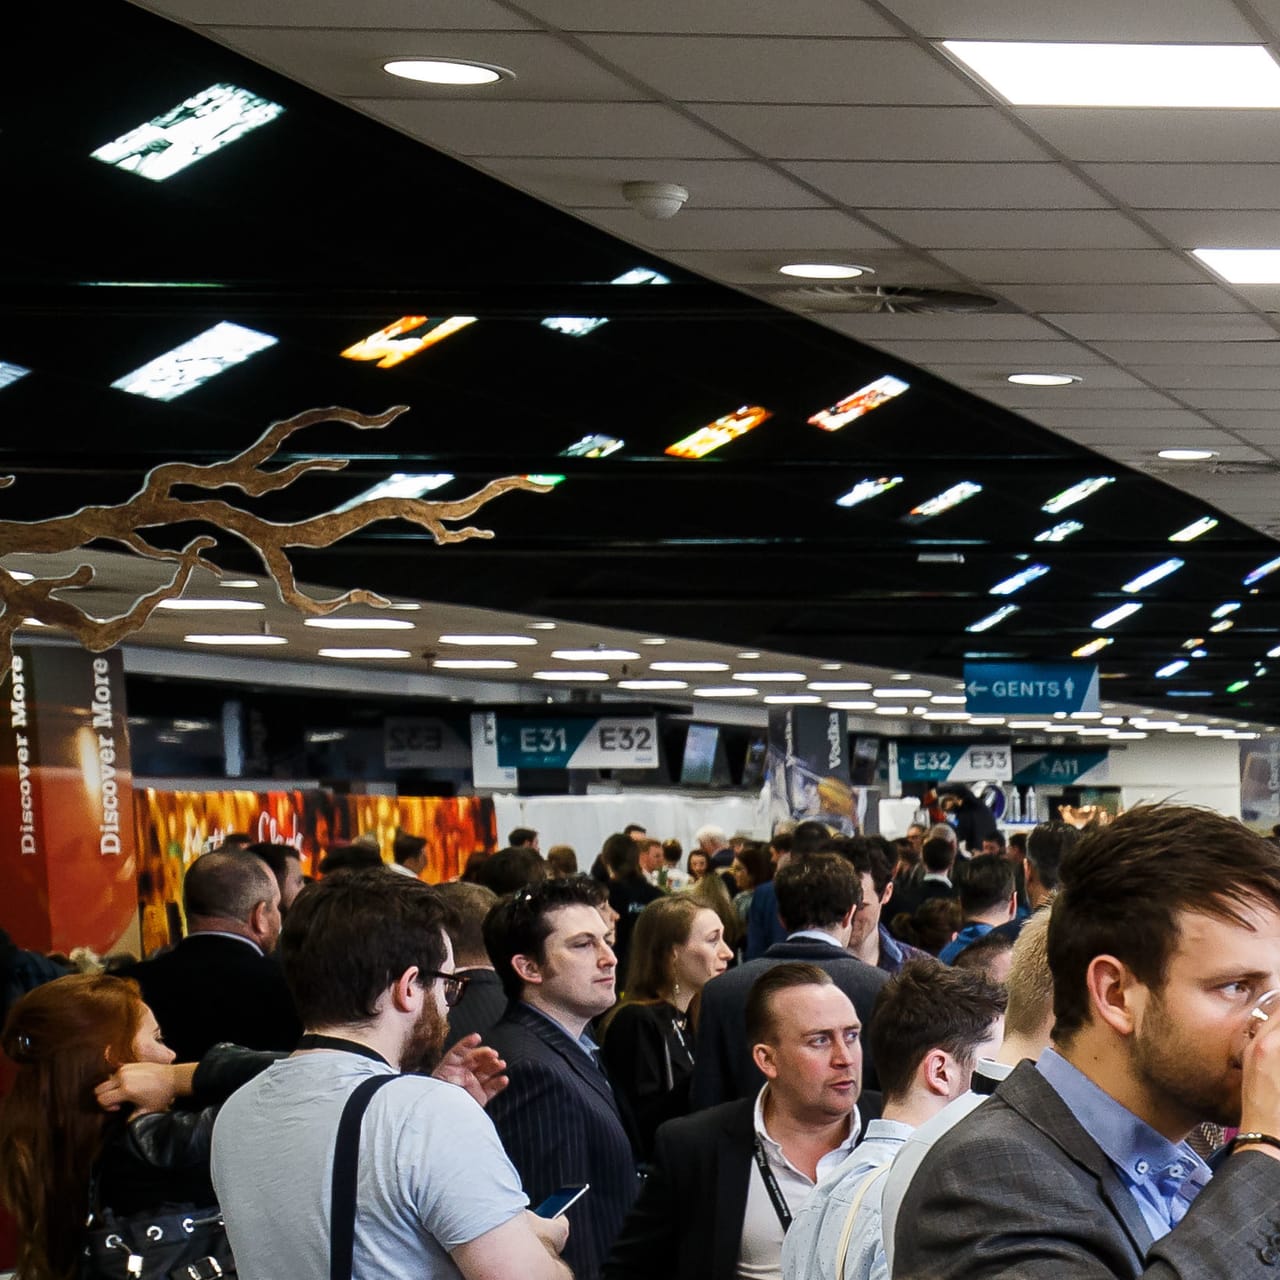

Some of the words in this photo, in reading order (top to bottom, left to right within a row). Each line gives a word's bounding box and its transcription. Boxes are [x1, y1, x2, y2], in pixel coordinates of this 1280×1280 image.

[11, 655, 28, 728] More
[92, 658, 114, 728] More
[992, 680, 1060, 698] GENTS
[520, 727, 567, 753] E31
[600, 726, 652, 752] E32
[913, 752, 951, 771] E32
[969, 751, 1008, 770] E33
[1051, 759, 1079, 775] A11
[17, 733, 36, 855] Discover
[100, 734, 121, 856] Discover
